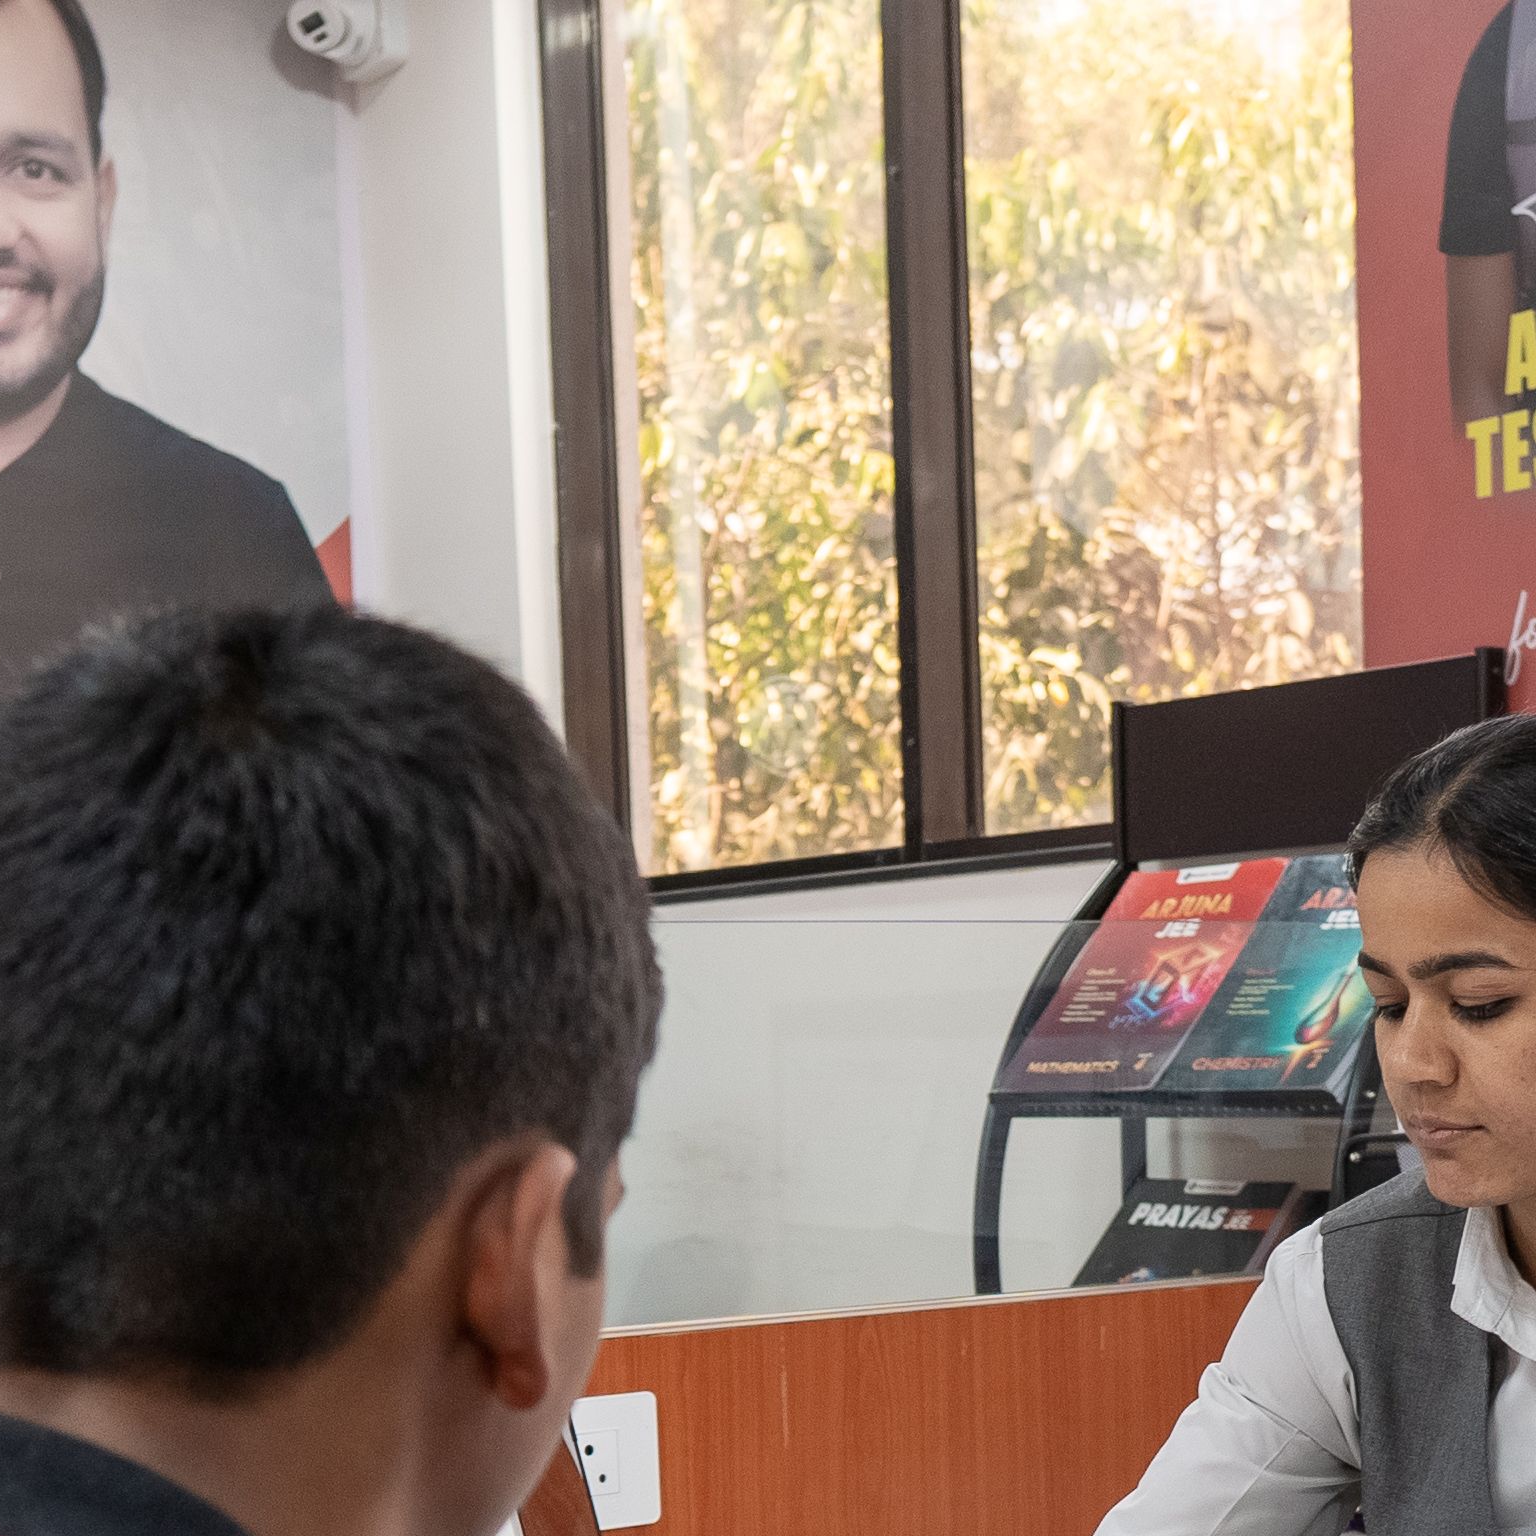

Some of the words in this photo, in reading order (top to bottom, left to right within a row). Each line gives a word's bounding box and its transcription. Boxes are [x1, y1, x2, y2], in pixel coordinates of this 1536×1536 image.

[1140, 893, 1233, 919] ARJUNA
[1154, 919, 1201, 938] JEE
[1128, 1202, 1229, 1231] PRAYAS
